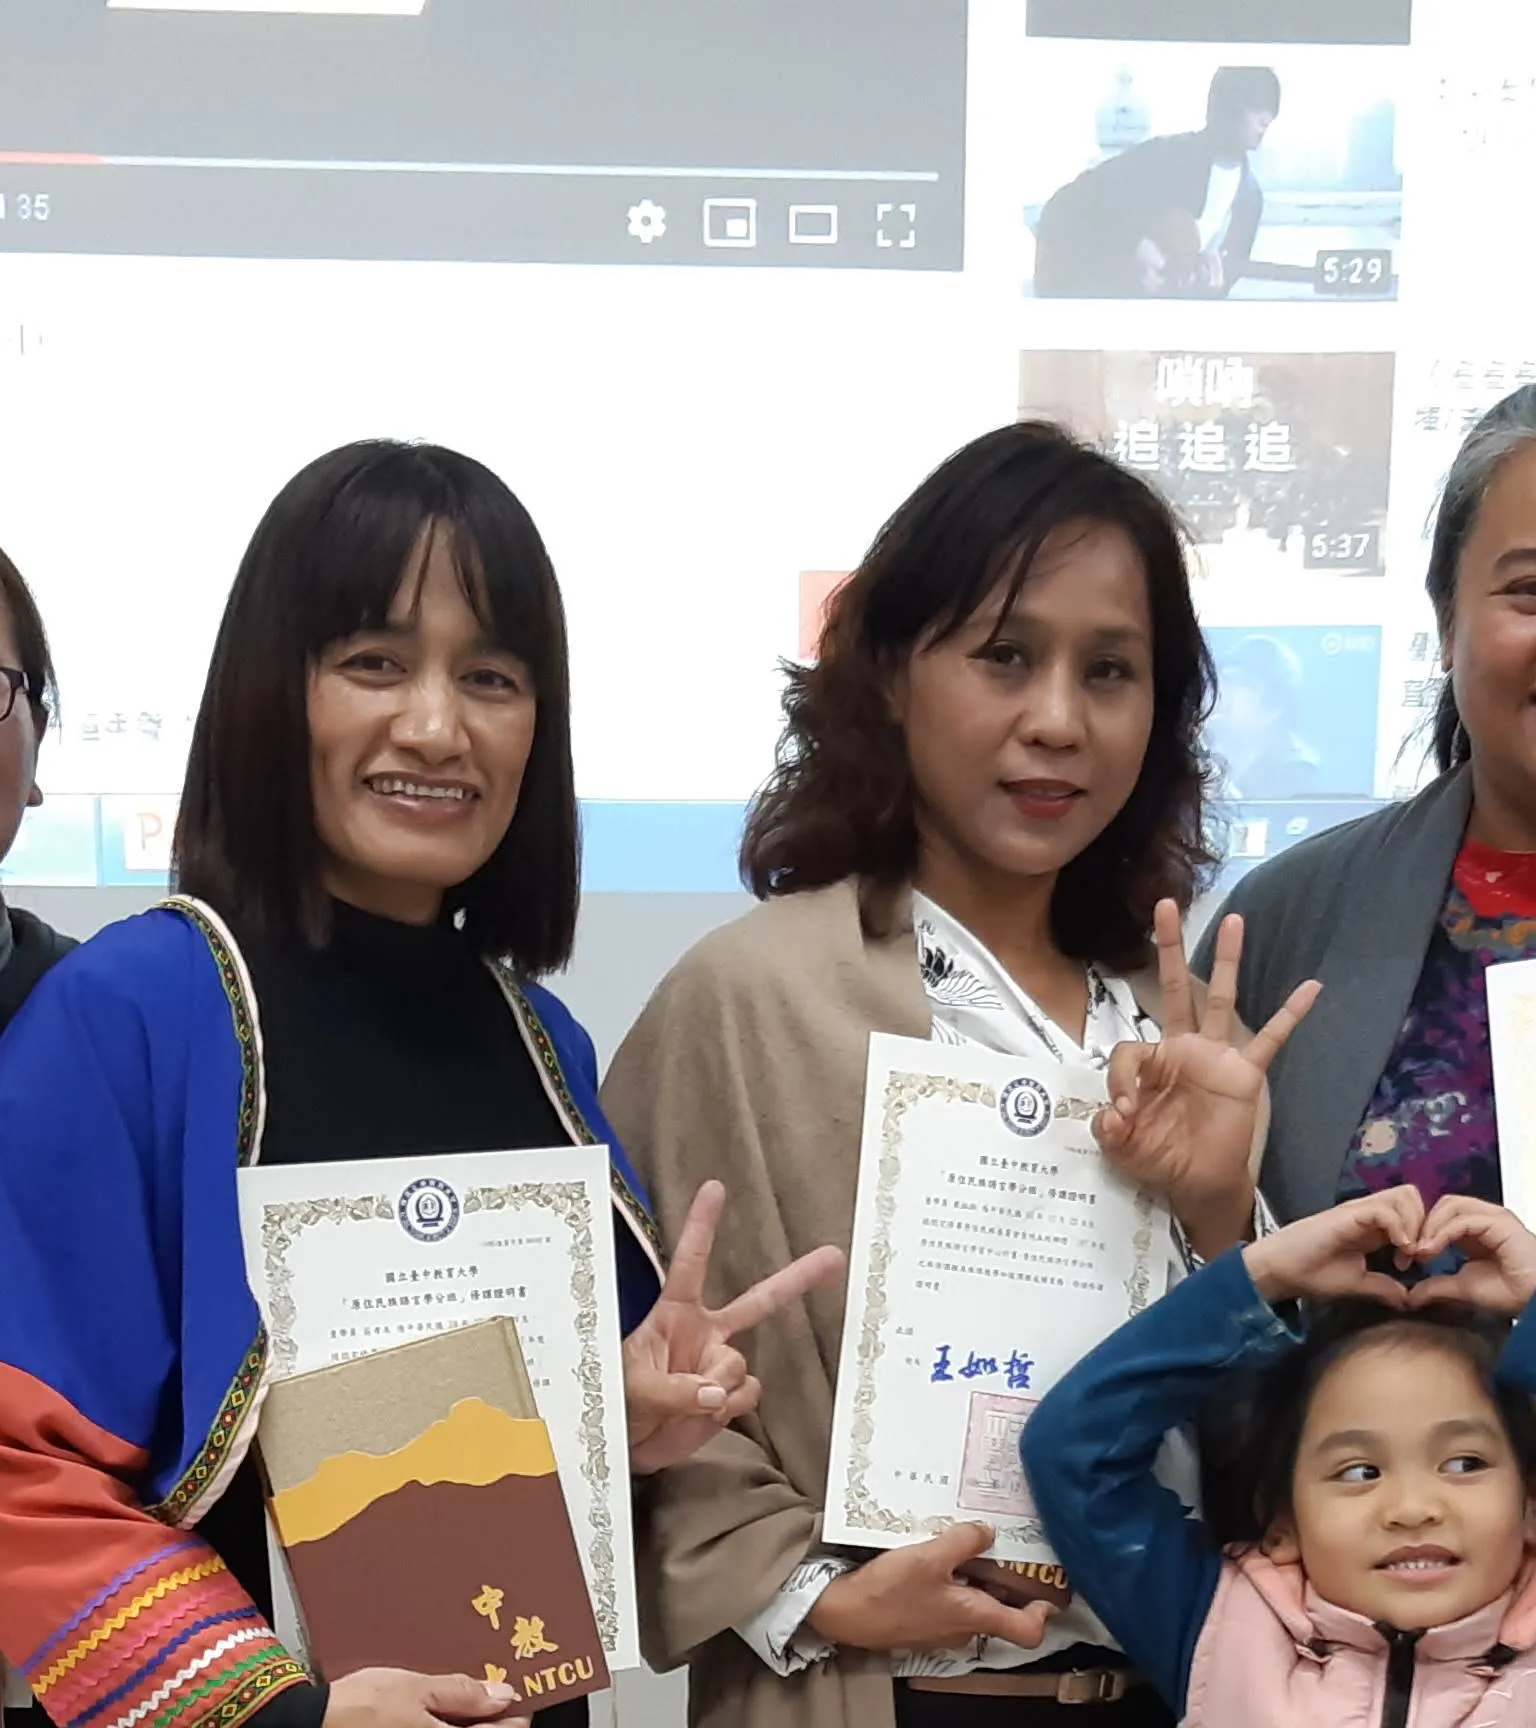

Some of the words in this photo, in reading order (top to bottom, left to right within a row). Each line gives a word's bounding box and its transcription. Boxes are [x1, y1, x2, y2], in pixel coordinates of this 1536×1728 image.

[1324, 256, 1382, 284] 5:29
[1311, 533, 1369, 559] 5:37
[523, 1655, 594, 1697] NTCU
